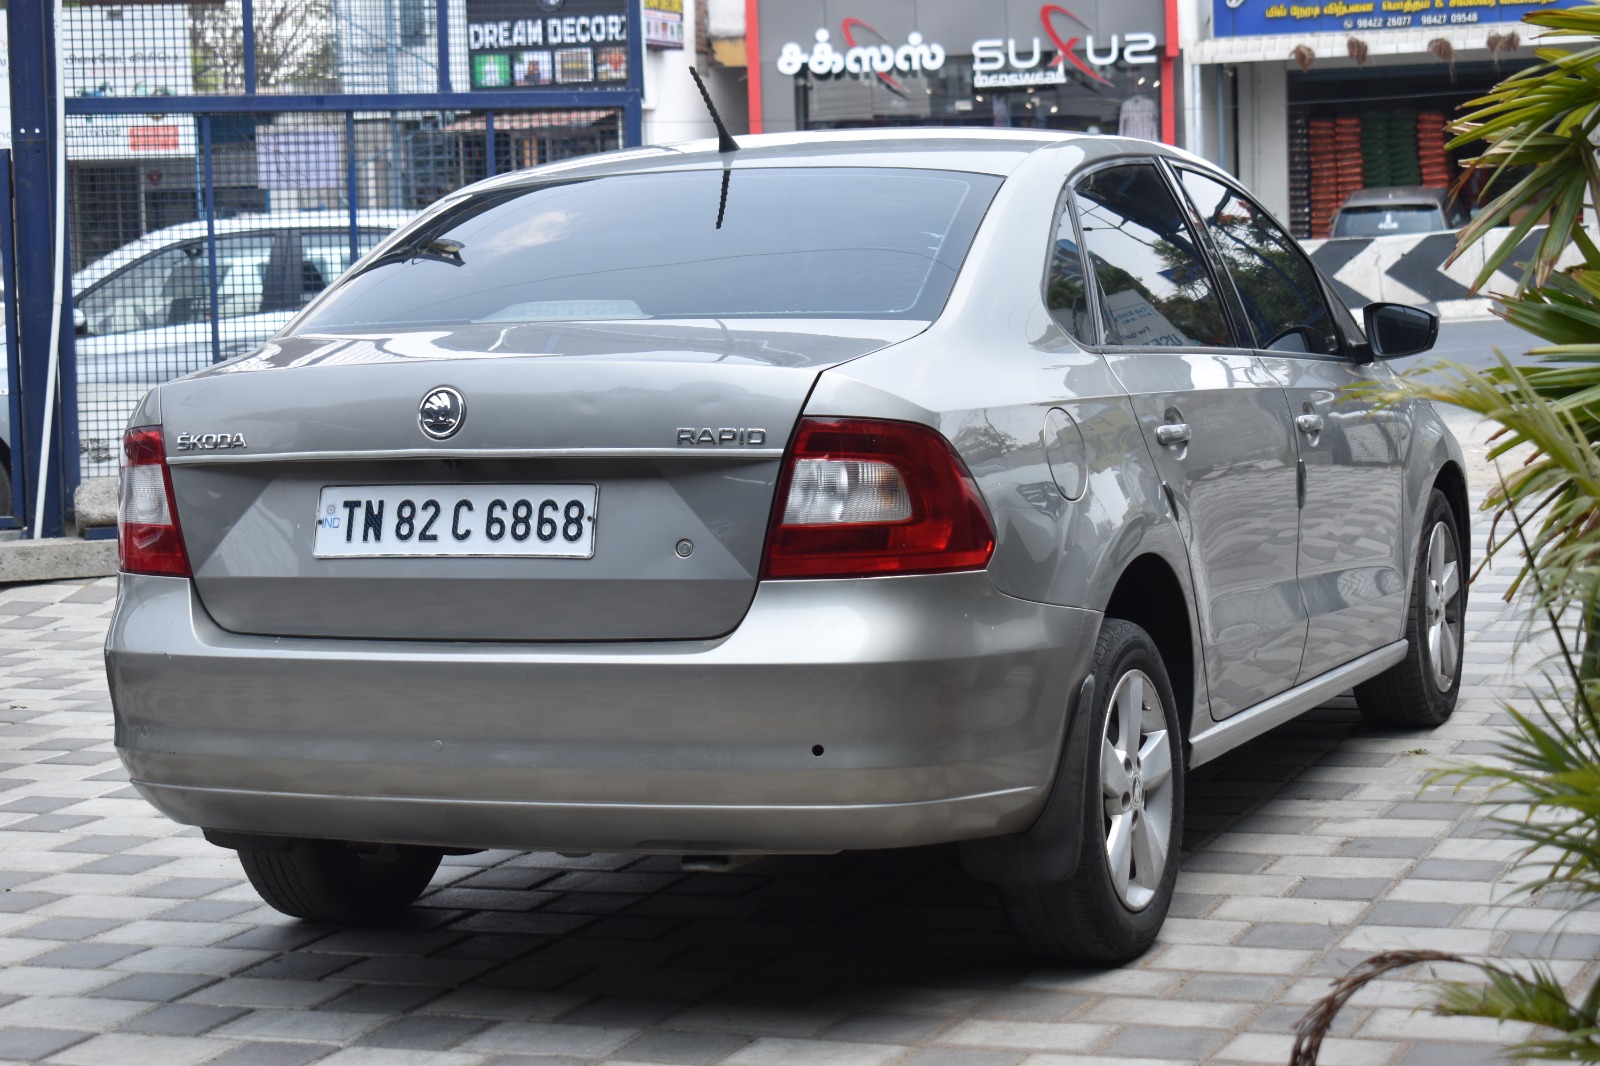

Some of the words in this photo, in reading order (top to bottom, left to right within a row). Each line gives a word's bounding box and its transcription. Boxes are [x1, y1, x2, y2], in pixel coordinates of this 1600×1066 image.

[469, 19, 543, 49] DREAM
[177, 432, 247, 450] ŠKODA
[676, 427, 766, 445] RAPID
[321, 517, 341, 529] IND
[343, 499, 385, 543] TN
[395, 498, 442, 542] 82
[451, 498, 475, 542] C
[485, 498, 586, 542] 6868
